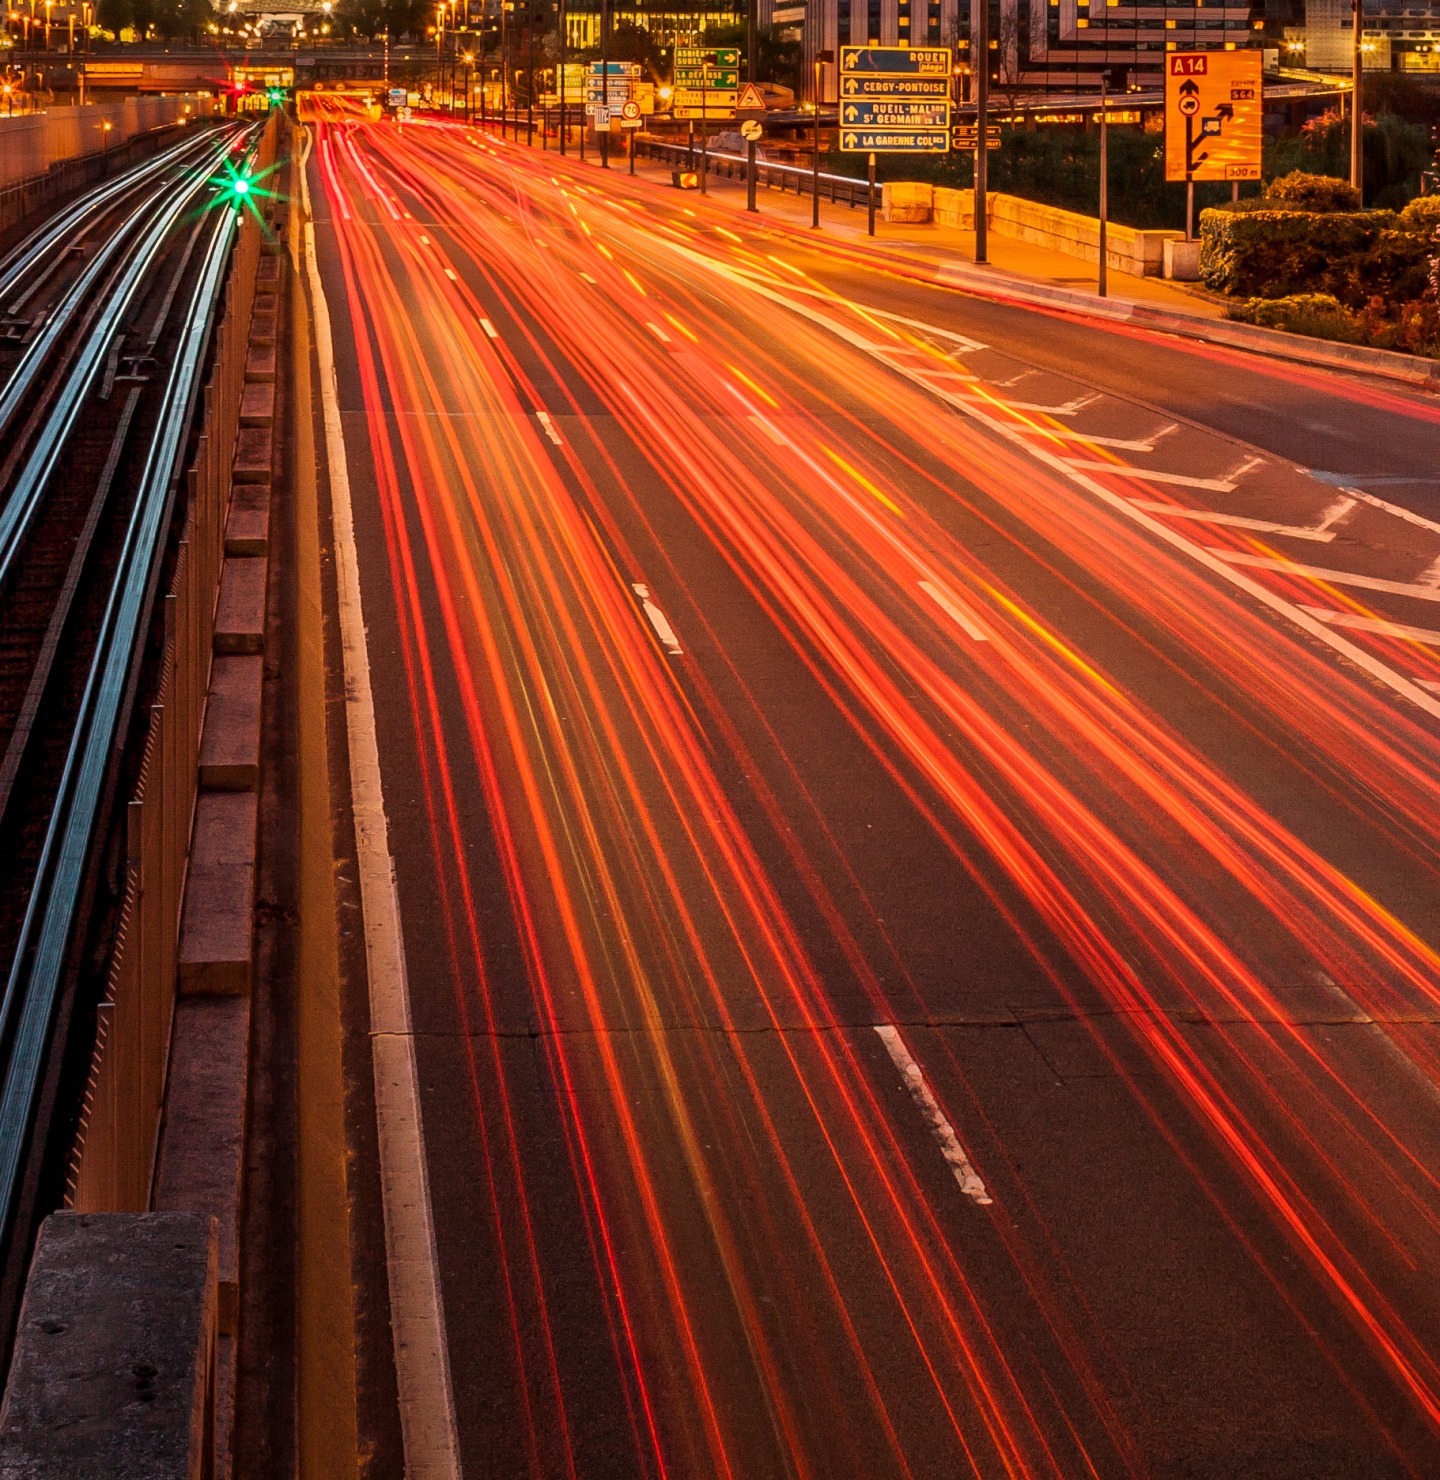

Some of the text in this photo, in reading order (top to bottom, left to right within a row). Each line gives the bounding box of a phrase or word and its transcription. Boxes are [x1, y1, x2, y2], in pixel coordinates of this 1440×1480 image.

[909, 52, 946, 61] ROUEN
[688, 70, 722, 79] DÉFNSE
[863, 82, 945, 93] CERGY-PONTOISE
[626, 106, 637, 114] 70
[876, 114, 921, 125] GERMAIN
[862, 135, 874, 145] LA
[875, 136, 916, 146] GARENNE
